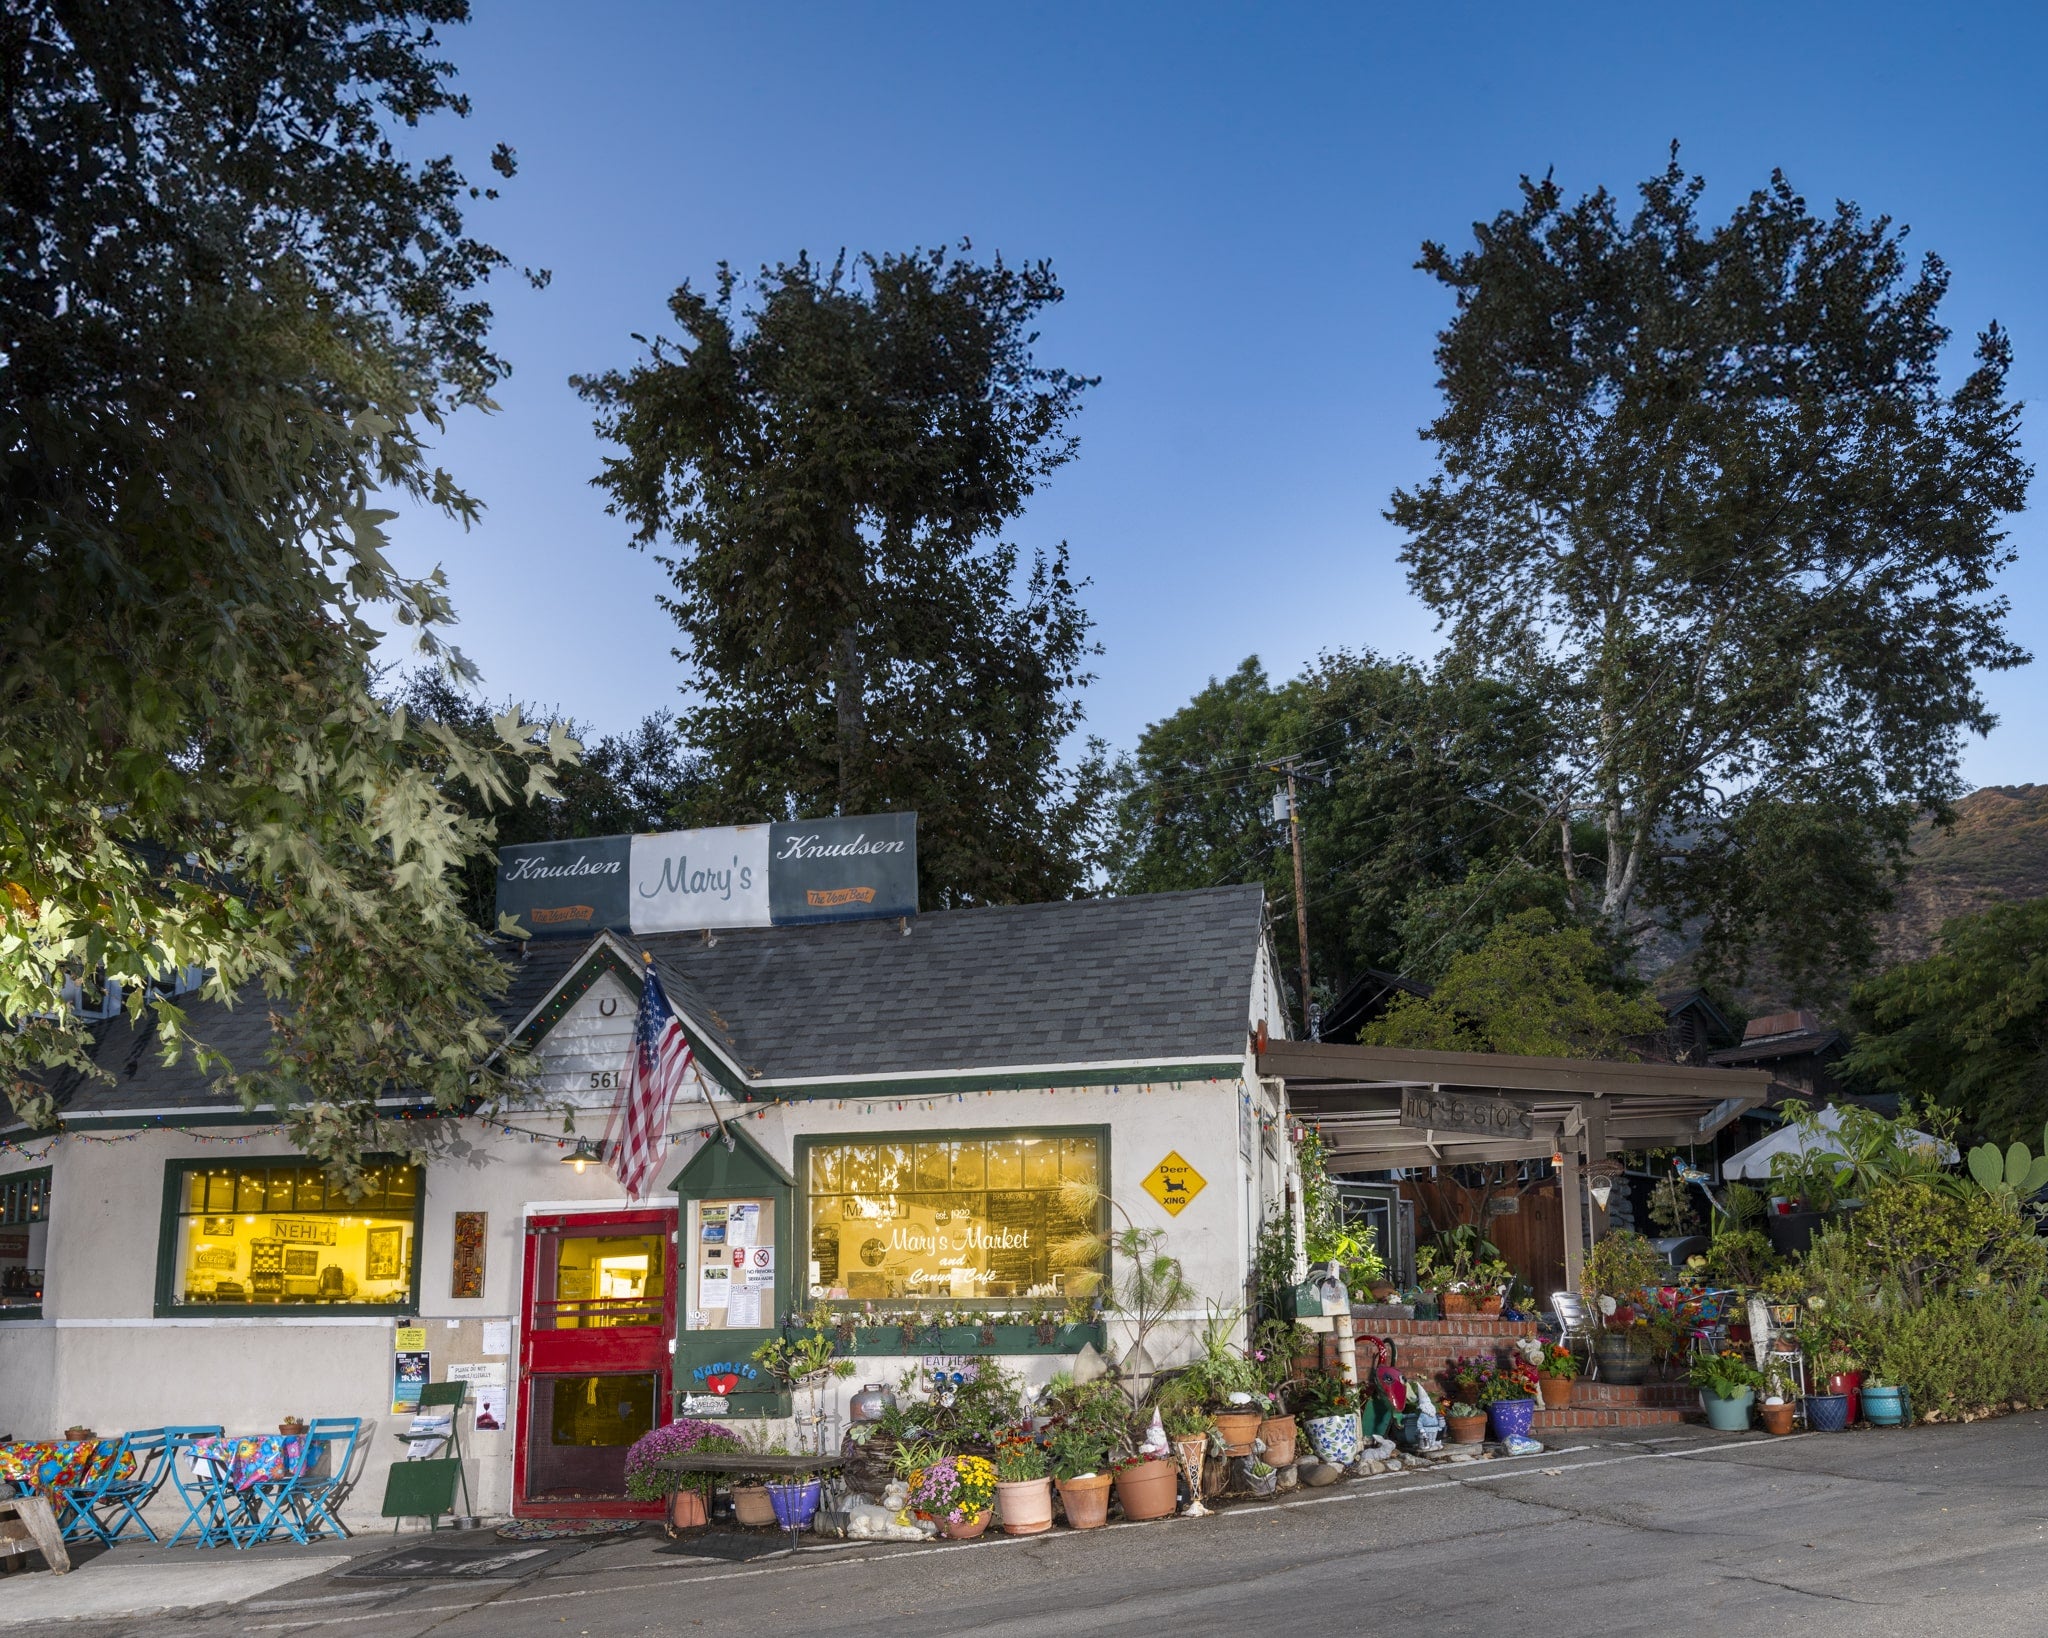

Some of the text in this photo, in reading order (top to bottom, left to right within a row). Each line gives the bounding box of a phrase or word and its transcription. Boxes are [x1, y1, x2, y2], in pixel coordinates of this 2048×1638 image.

[776, 833, 905, 859] Knudsen
[505, 855, 621, 880] Knudsen
[638, 854, 752, 901] Mary's
[810, 888, 870, 904] The Very Best
[536, 907, 588, 921] The Very Best
[590, 1072, 619, 1089] 561
[1160, 1165, 1189, 1174] Deer
[1163, 1196, 1186, 1205] XING
[935, 1208, 971, 1220] est. 1922
[275, 1223, 317, 1239] NEHI
[877, 1226, 1030, 1257] Mary's Market
[939, 1254, 966, 1266] and
[909, 1268, 959, 1285] Canyo
[925, 1356, 945, 1366] EAT
[693, 1361, 757, 1384] Namaste
